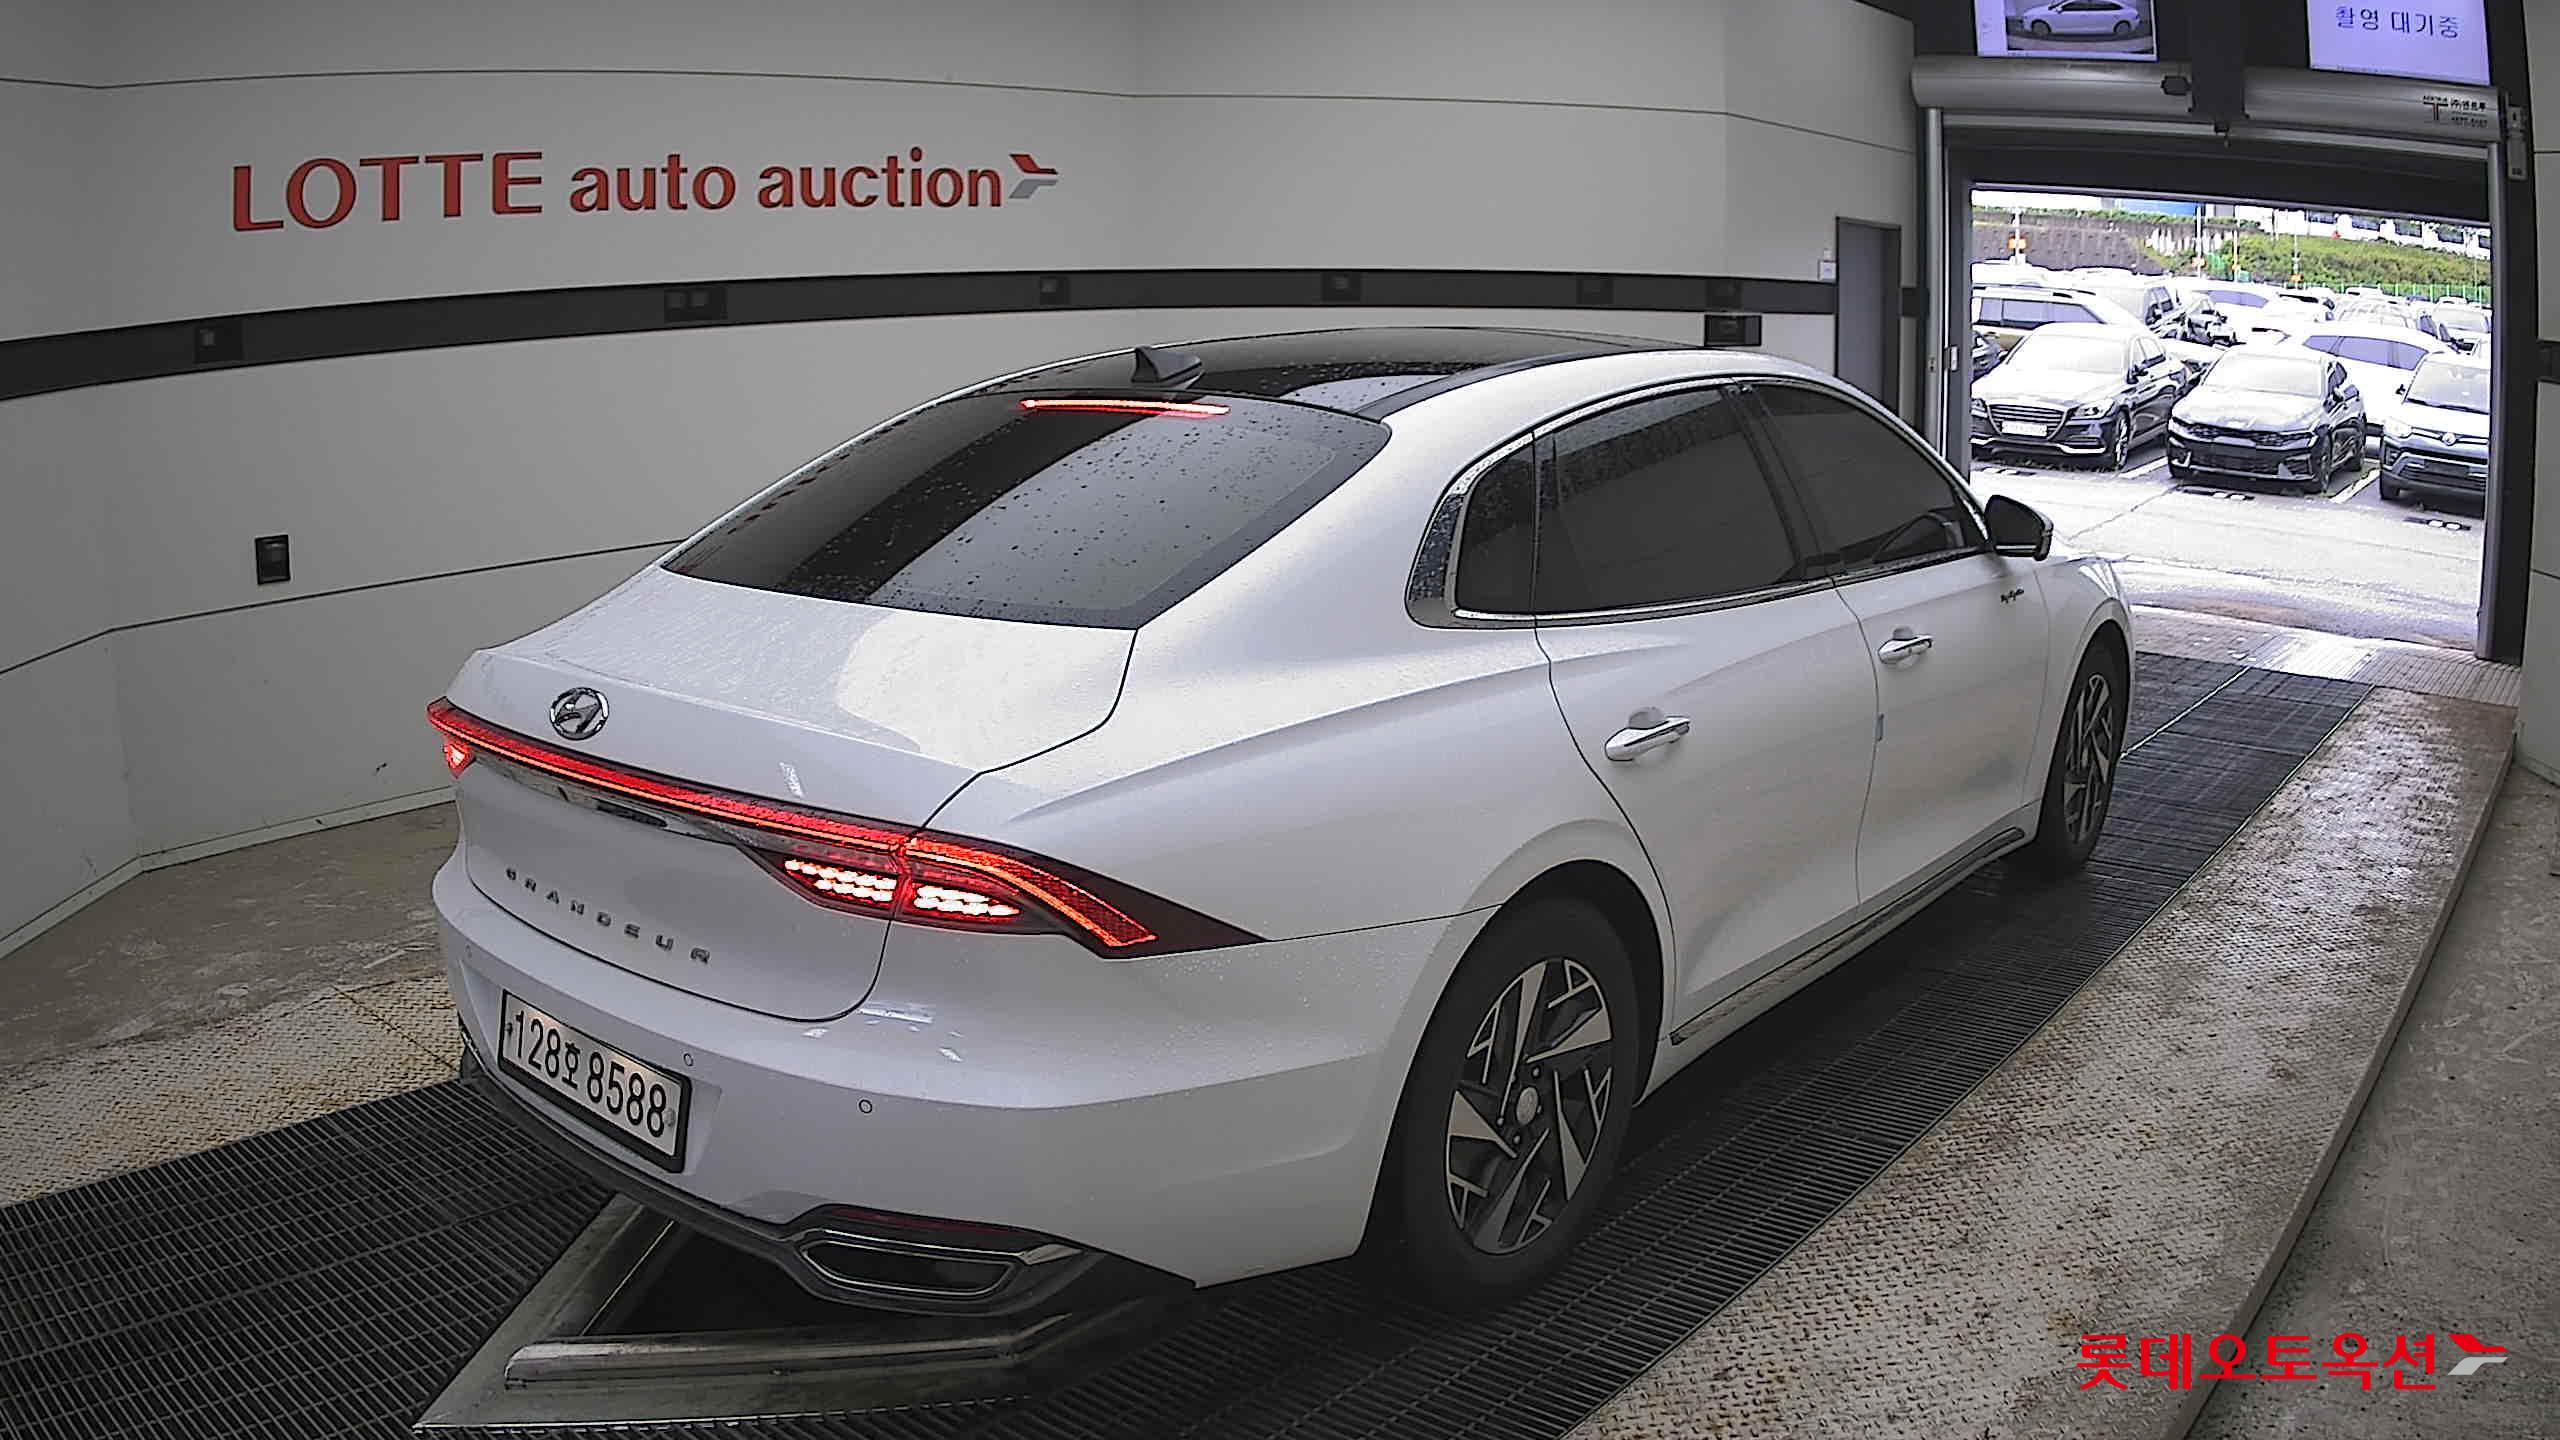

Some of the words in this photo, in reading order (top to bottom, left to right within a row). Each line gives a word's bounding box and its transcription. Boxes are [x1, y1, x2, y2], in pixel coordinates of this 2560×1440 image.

[2335, 6, 2379, 31] 촬영
[2391, 11, 2459, 39] 대기중
[233, 151, 543, 231] LOTTE
[569, 153, 737, 211] auto
[757, 147, 1003, 209] auction
[505, 867, 711, 964] GRANDEUR
[515, 1010, 581, 1090] 128호
[586, 1051, 667, 1138] 8588
